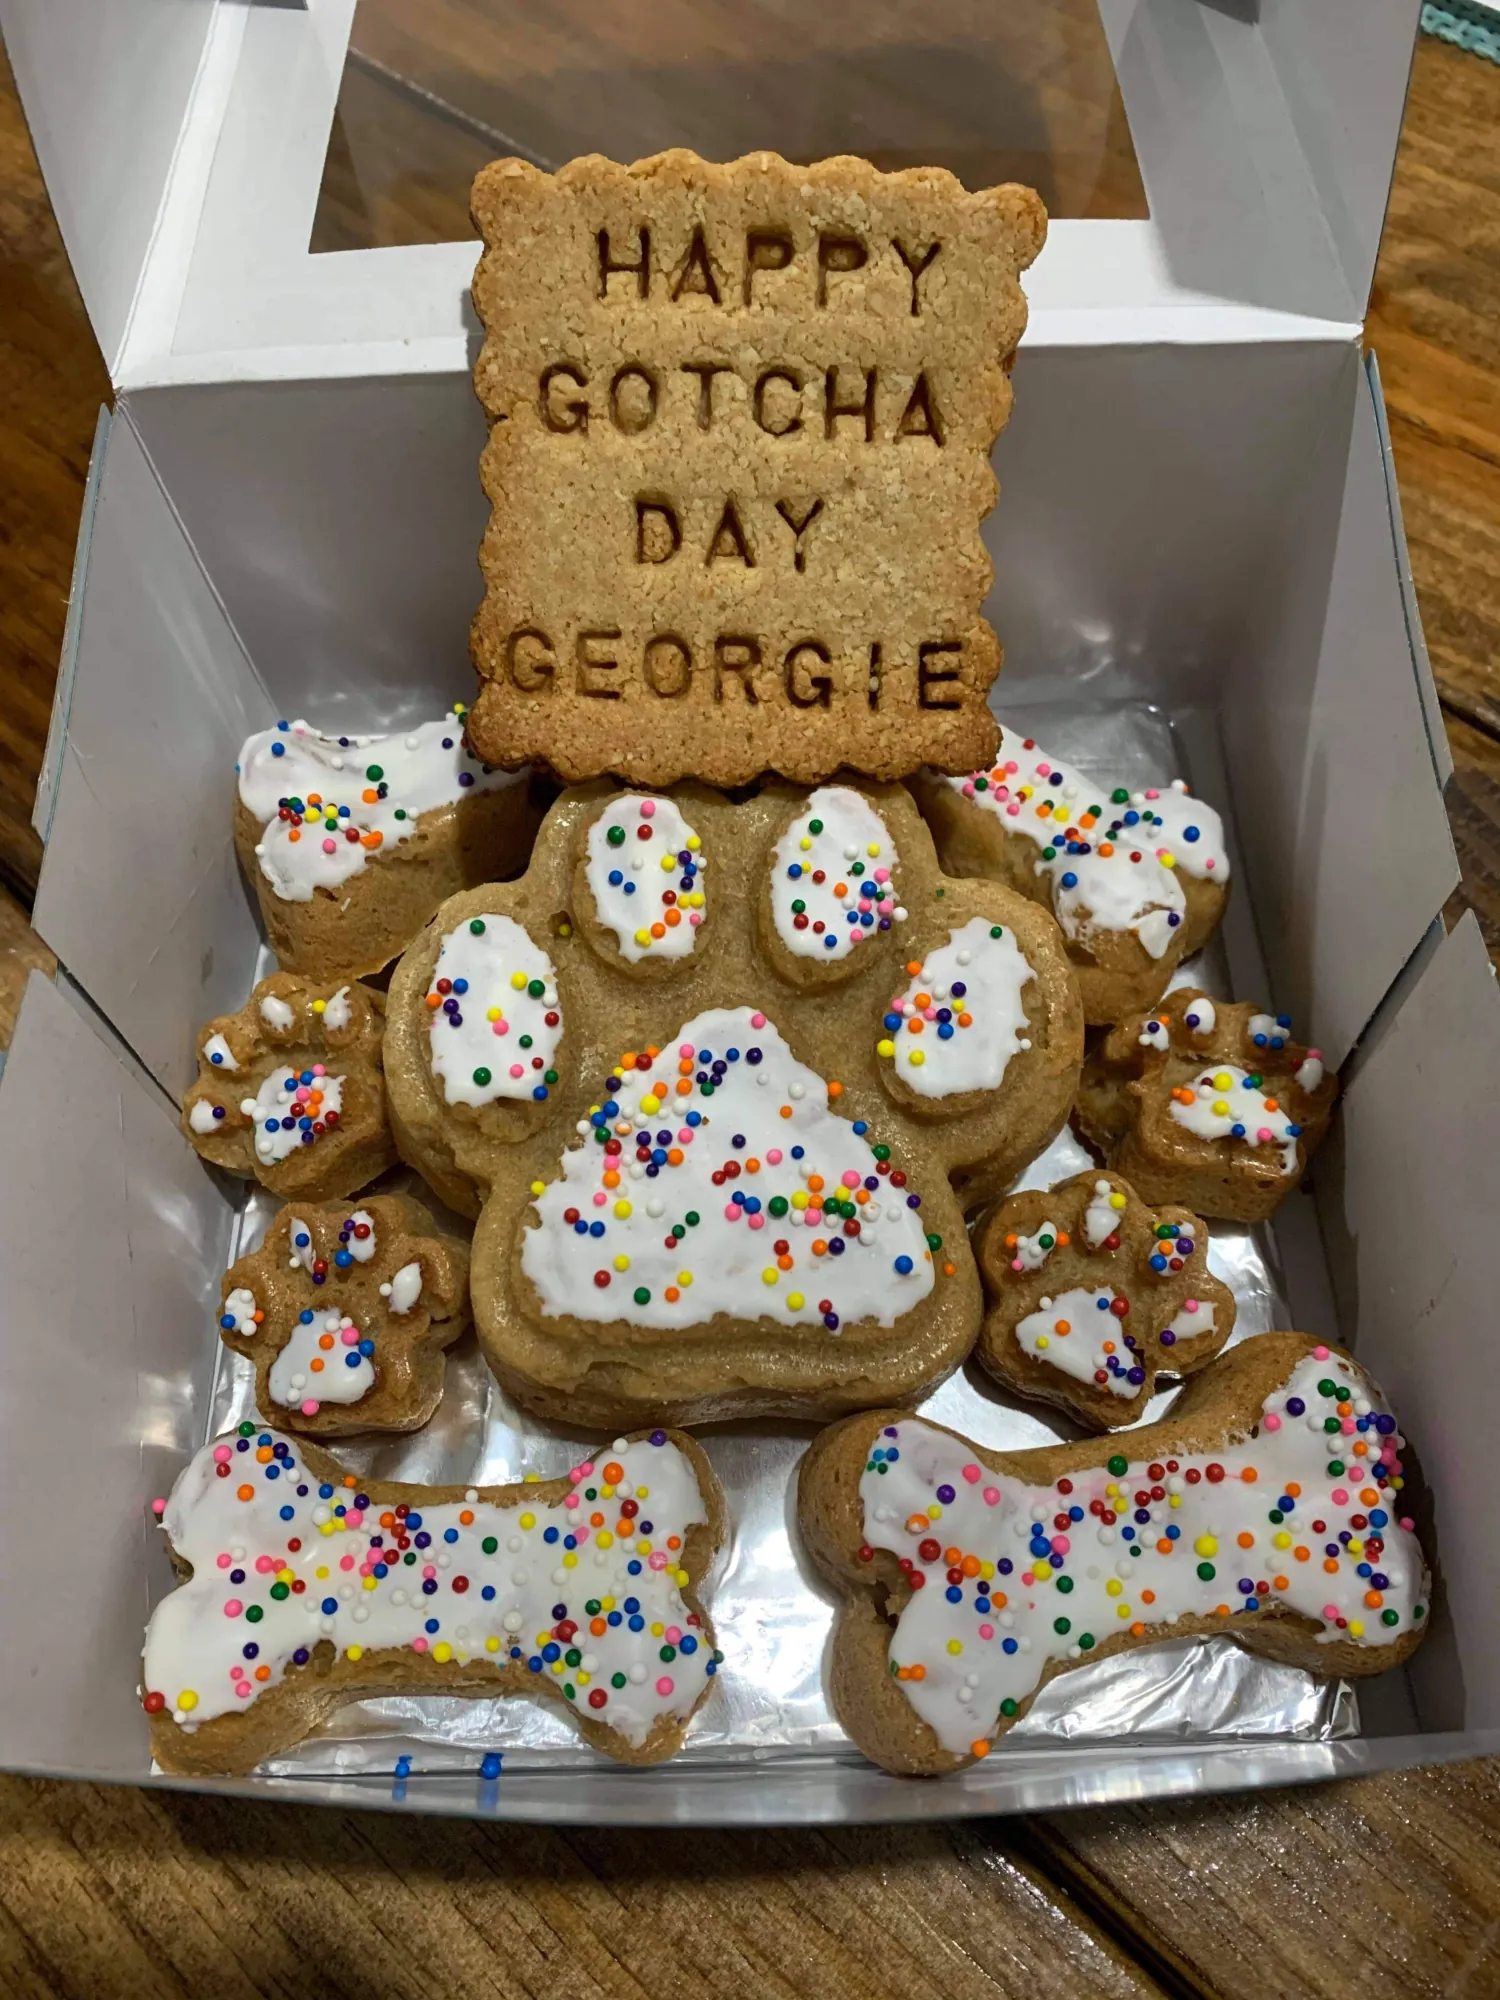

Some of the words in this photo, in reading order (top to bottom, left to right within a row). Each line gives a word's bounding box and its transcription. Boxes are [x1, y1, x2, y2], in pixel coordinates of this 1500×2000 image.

[597, 226, 943, 316] HAPPY
[538, 363, 945, 447] GOTCHA
[635, 492, 824, 572] DAY
[507, 628, 965, 710] GEORGIE
